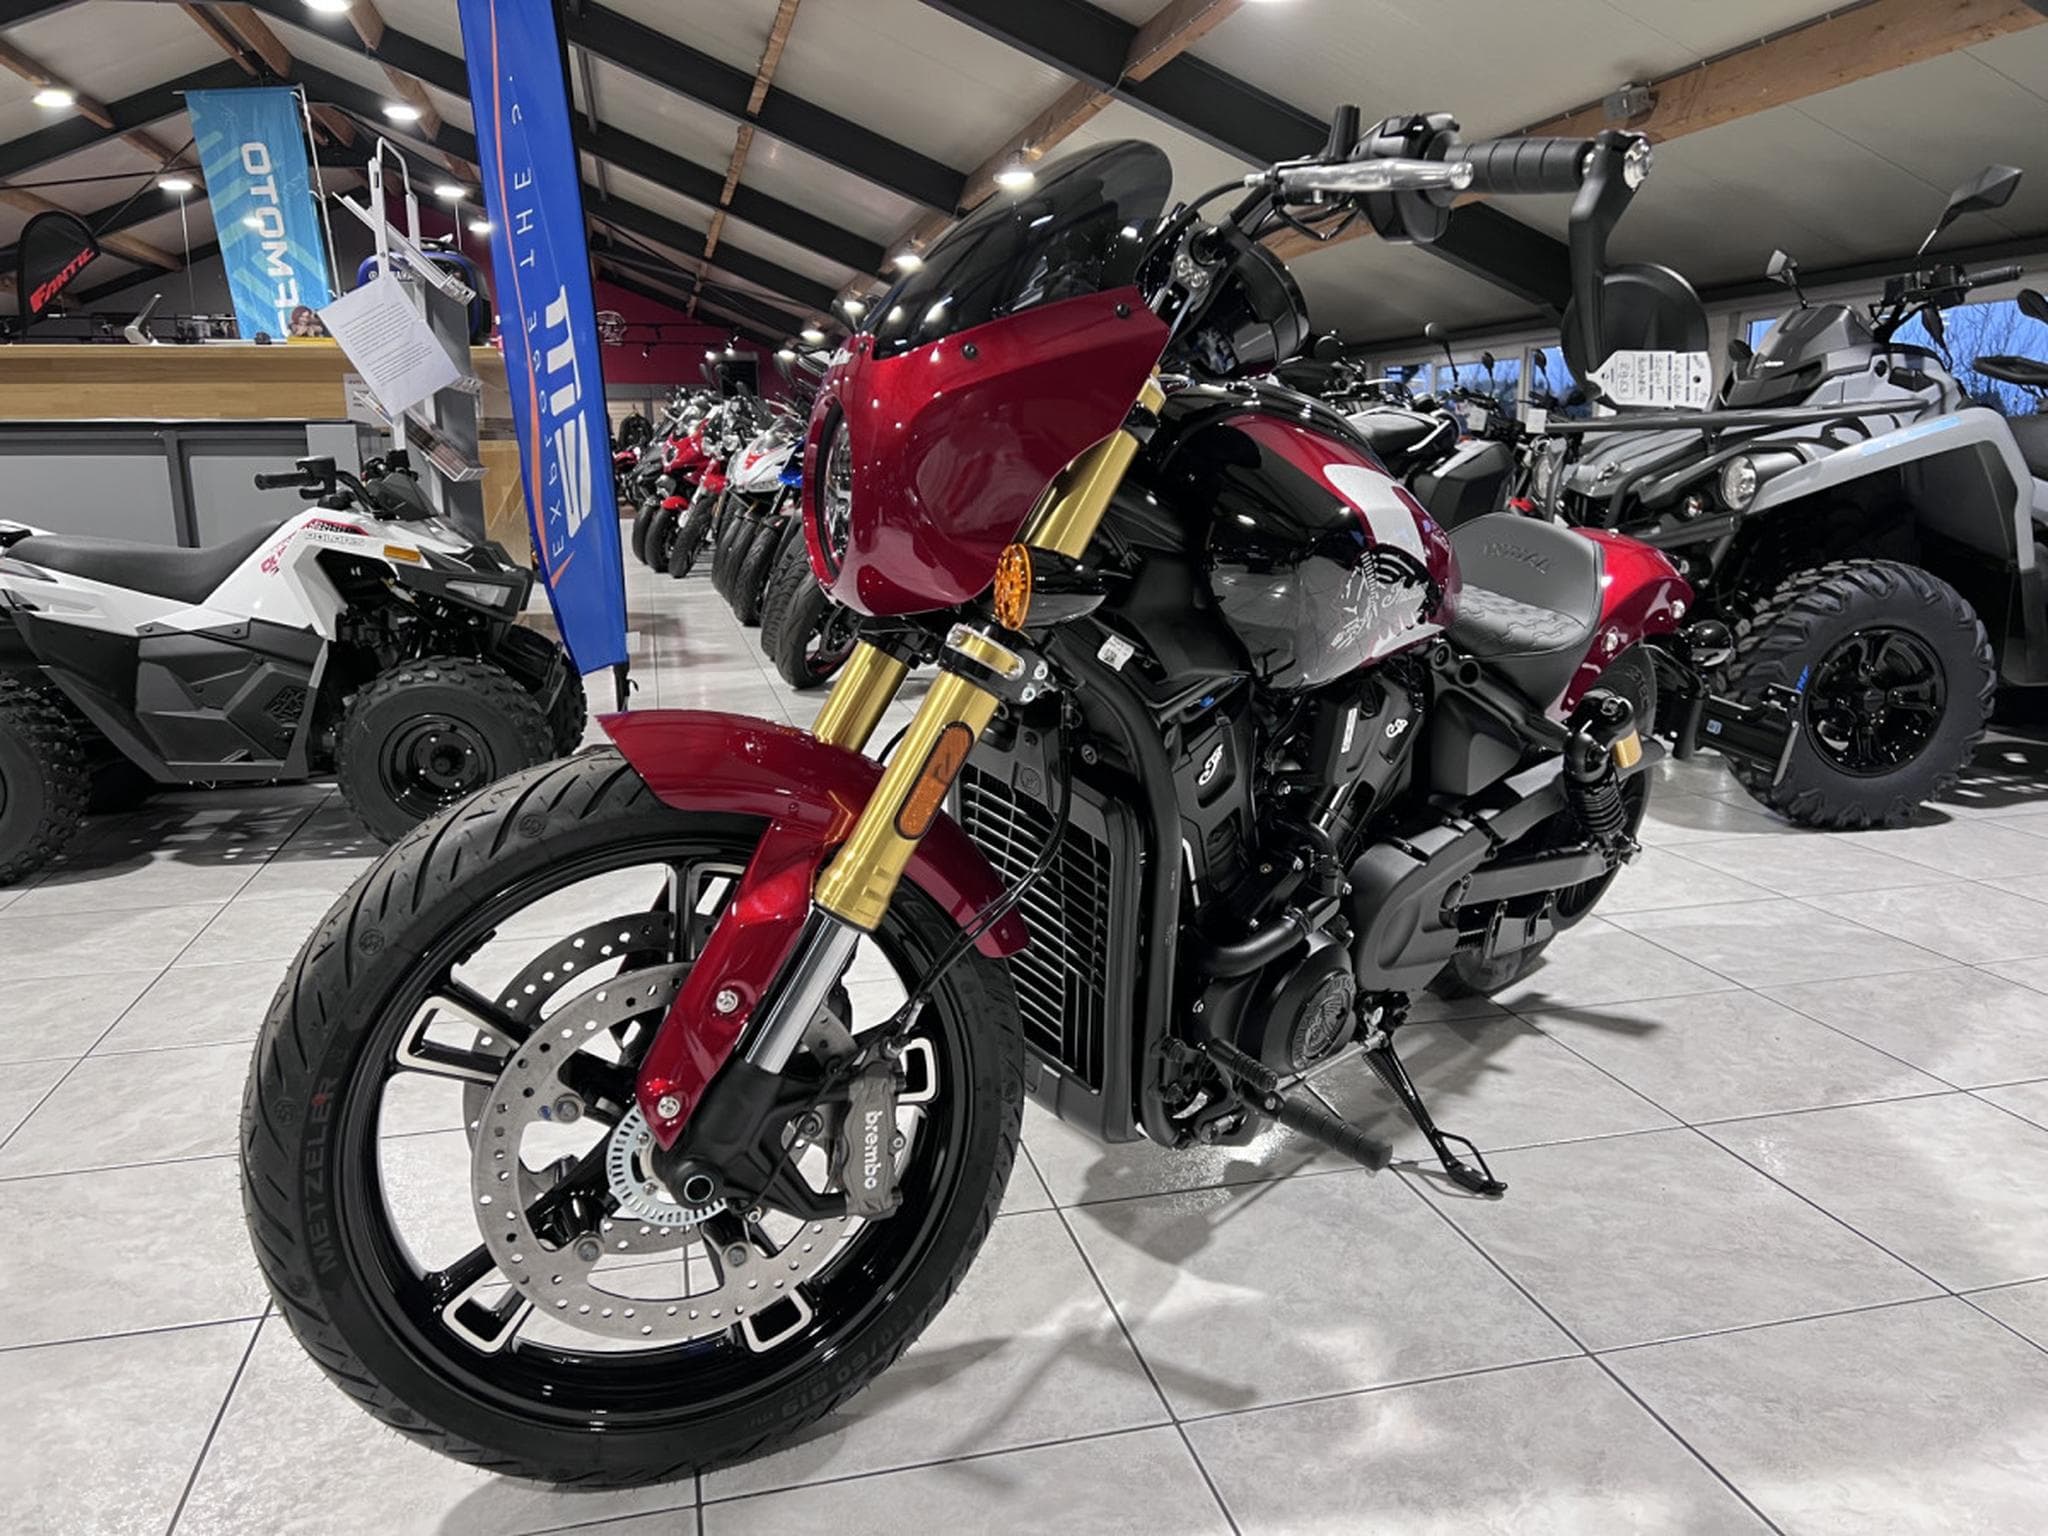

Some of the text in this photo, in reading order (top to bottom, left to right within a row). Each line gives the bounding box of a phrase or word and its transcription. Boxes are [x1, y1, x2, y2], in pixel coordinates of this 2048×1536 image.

[30, 247, 95, 313] FANTIC
[303, 1076, 339, 1274] METZELER
[864, 1110, 883, 1189] brembo
